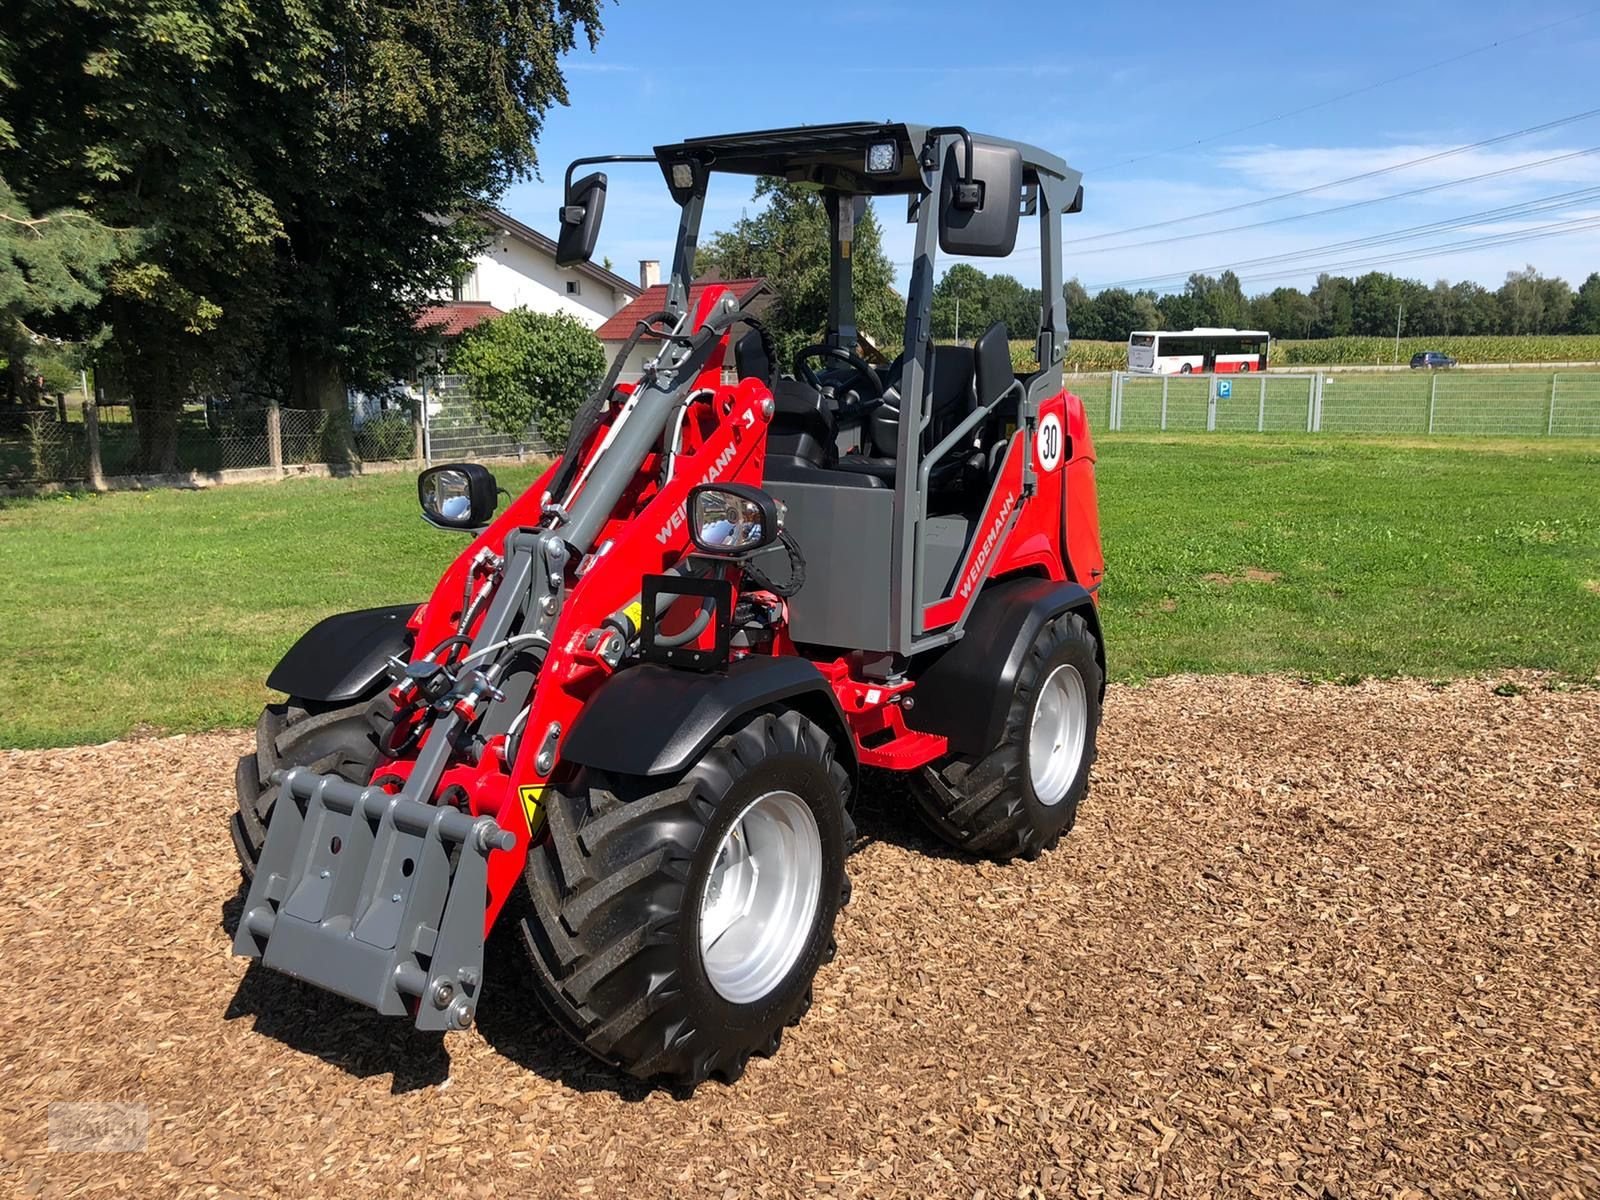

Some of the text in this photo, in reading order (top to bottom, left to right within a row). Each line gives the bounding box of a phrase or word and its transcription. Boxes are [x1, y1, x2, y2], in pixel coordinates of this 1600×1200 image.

[656, 441, 736, 544] WEIANN
[1043, 424, 1057, 460] 30
[960, 491, 1014, 599] WEIDEMANN
